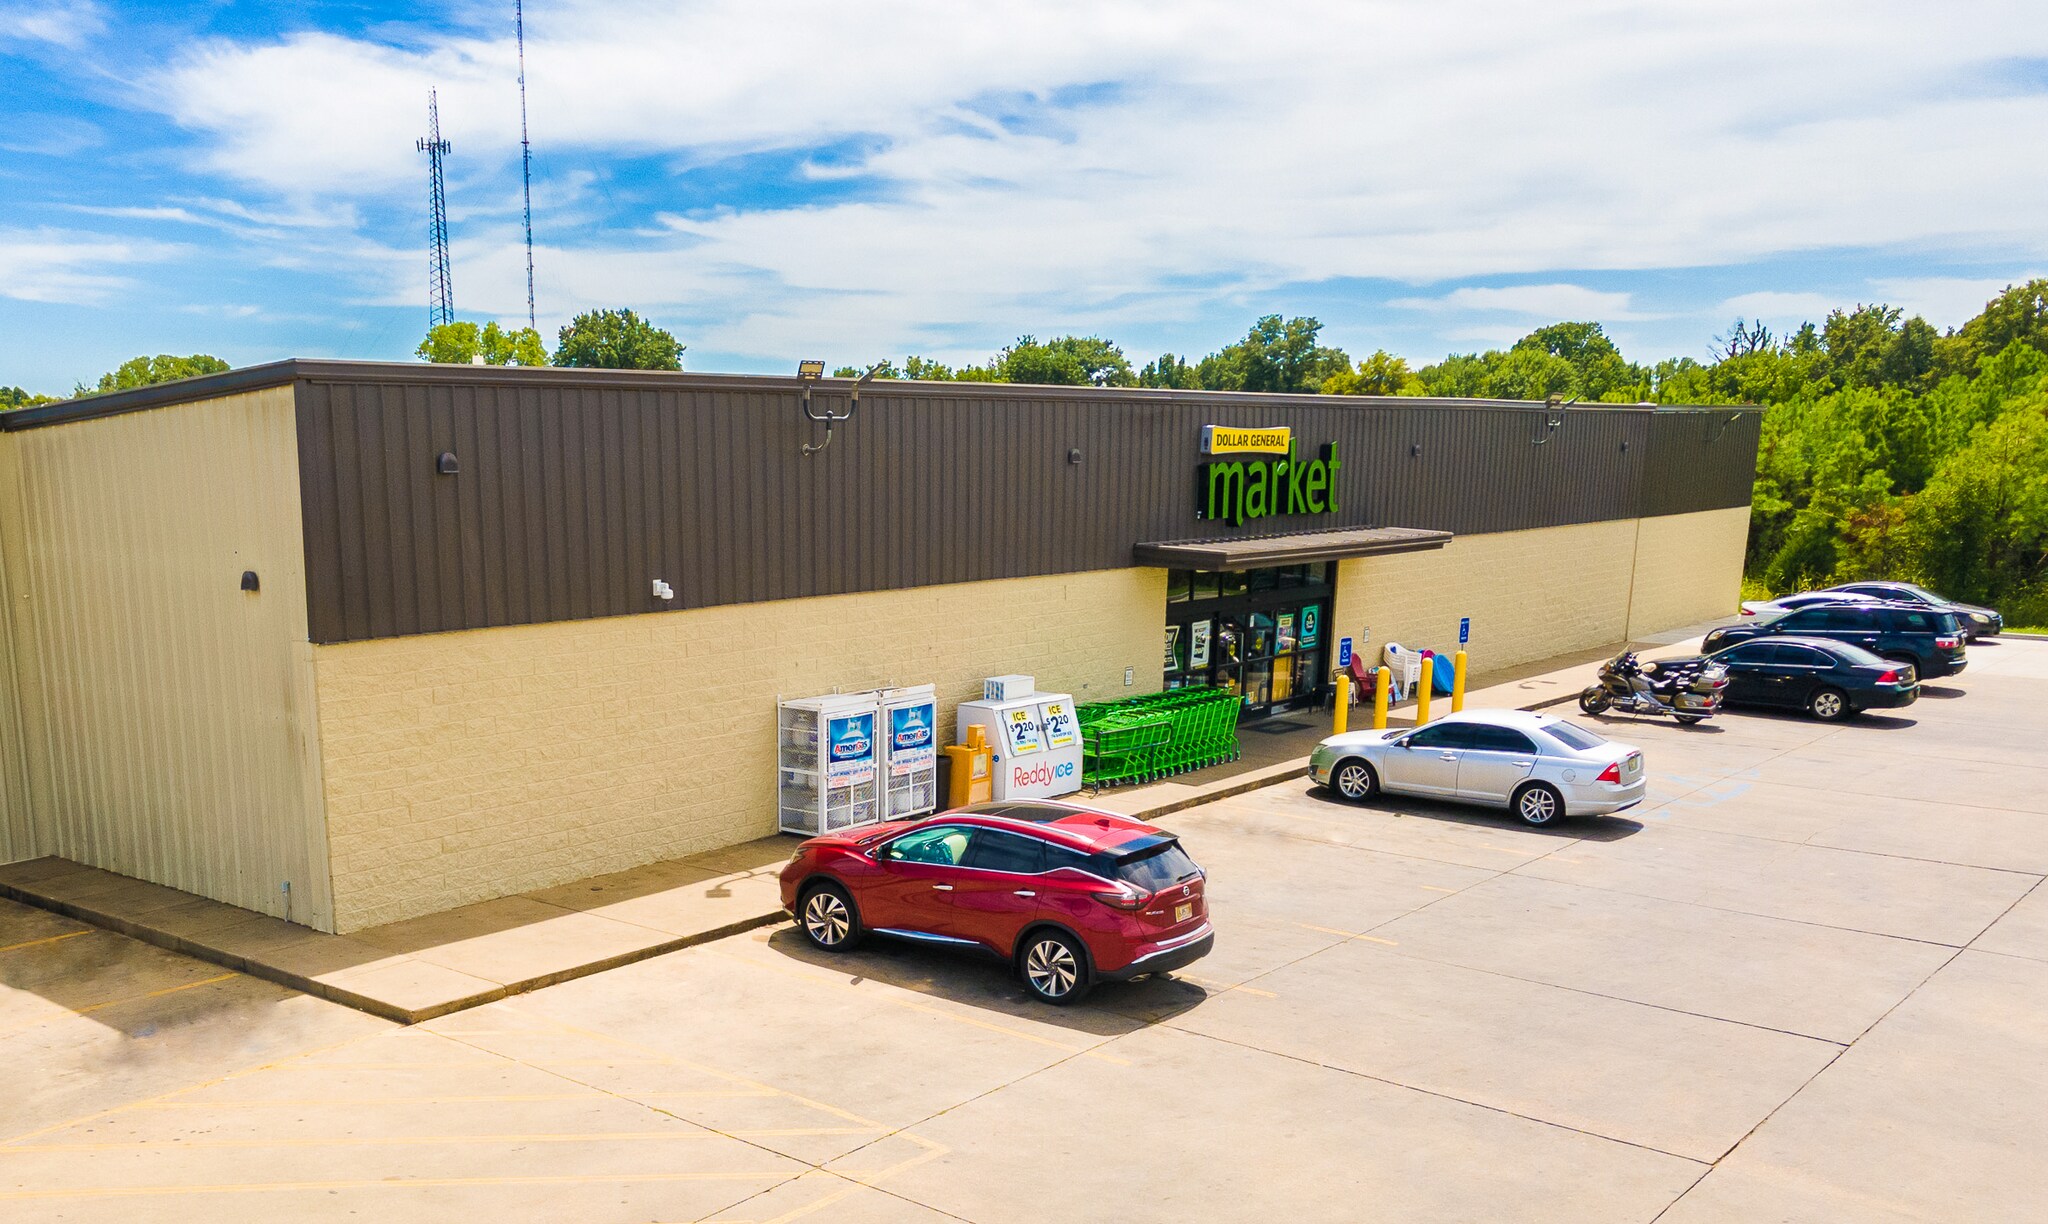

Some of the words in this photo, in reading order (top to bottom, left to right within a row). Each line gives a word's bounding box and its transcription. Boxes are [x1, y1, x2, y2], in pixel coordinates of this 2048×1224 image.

[1216, 434, 1248, 446] DOLLAR
[1251, 434, 1285, 447] GENERAL
[1208, 437, 1341, 527] market
[1048, 705, 1062, 715] ICE
[1012, 711, 1027, 721] ICE
